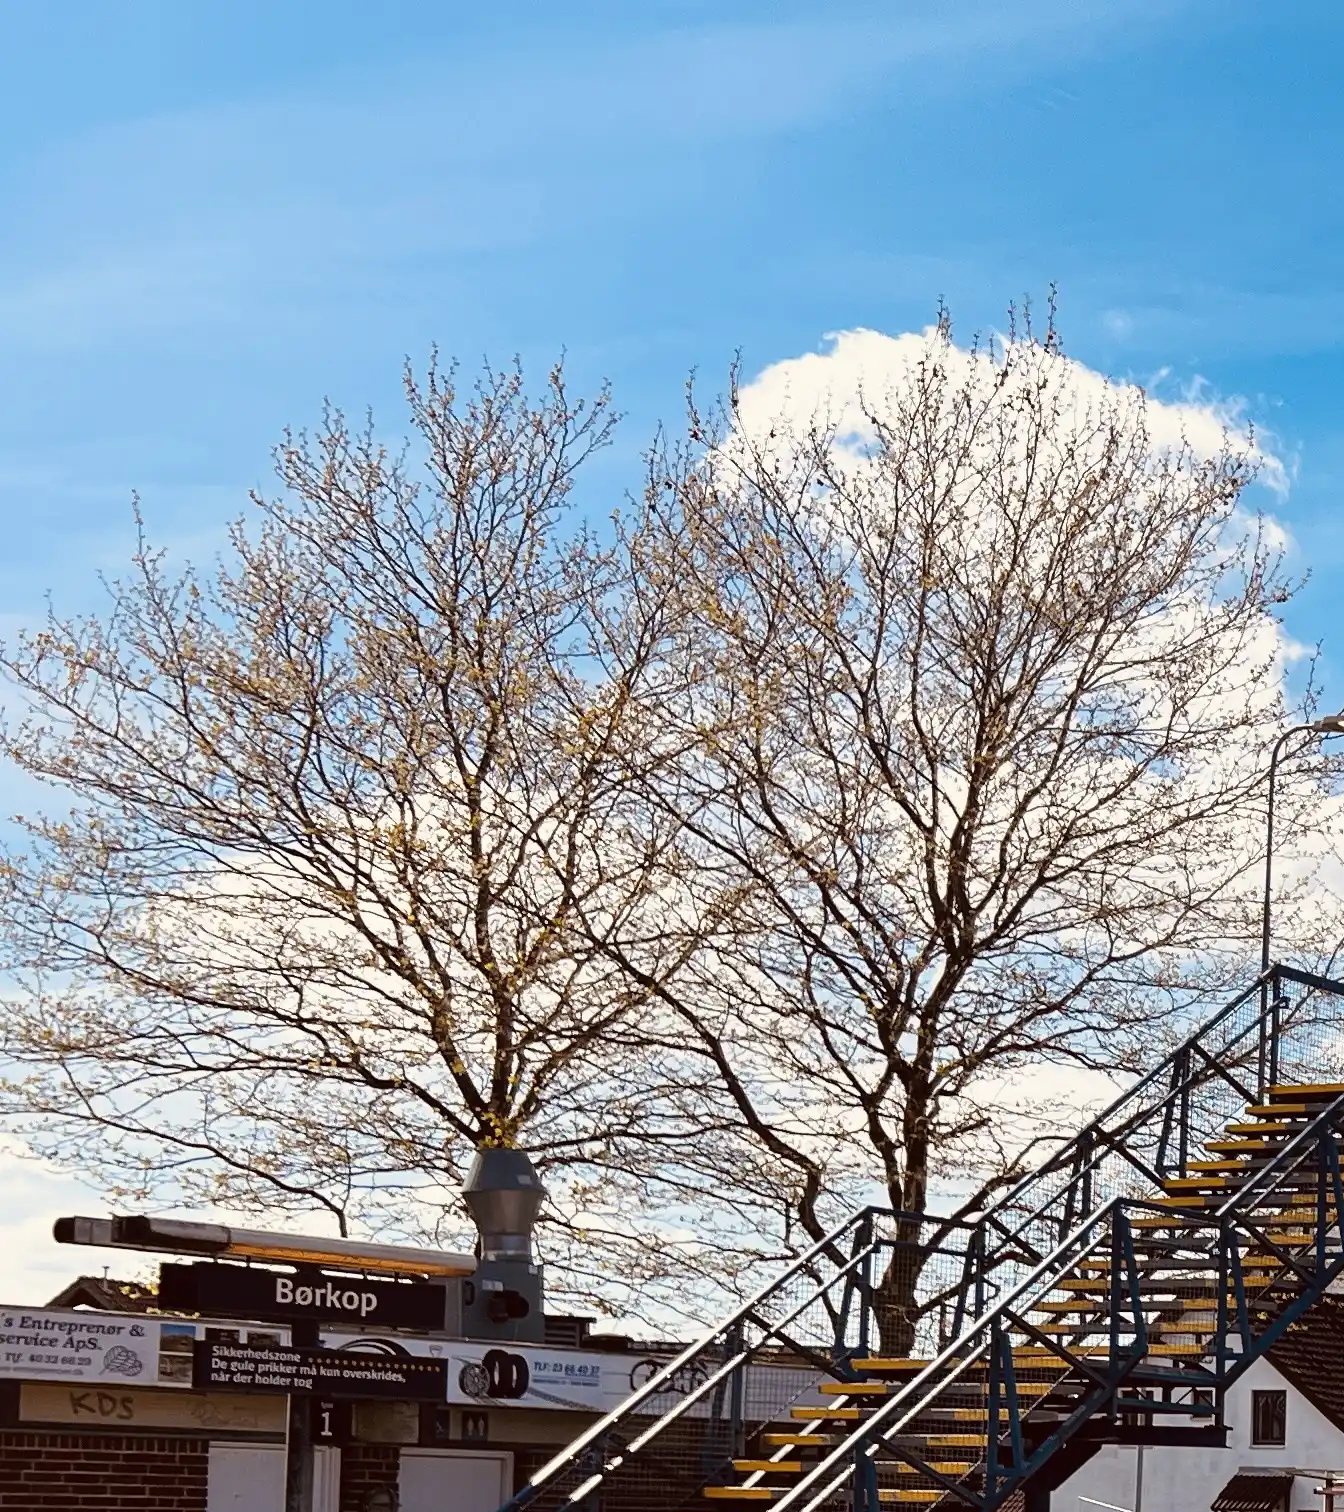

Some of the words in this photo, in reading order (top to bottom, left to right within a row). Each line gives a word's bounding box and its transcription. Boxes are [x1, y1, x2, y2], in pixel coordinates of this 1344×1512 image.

[275, 1278, 378, 1317] Børkop
[20, 1315, 126, 1336] Entreprenør
[212, 1345, 301, 1363] Sikkerhedszone
[210, 1371, 231, 1382] når
[232, 1373, 254, 1384] der
[254, 1373, 292, 1386] holder
[293, 1377, 313, 1390] tog
[211, 1358, 228, 1370] De
[230, 1360, 256, 1372] gule
[257, 1361, 297, 1374] prikker
[299, 1364, 317, 1376] må
[319, 1365, 340, 1377] kun
[342, 1369, 406, 1383] overskrides,
[69, 1391, 135, 1420] KDS
[321, 1411, 333, 1437] 1
